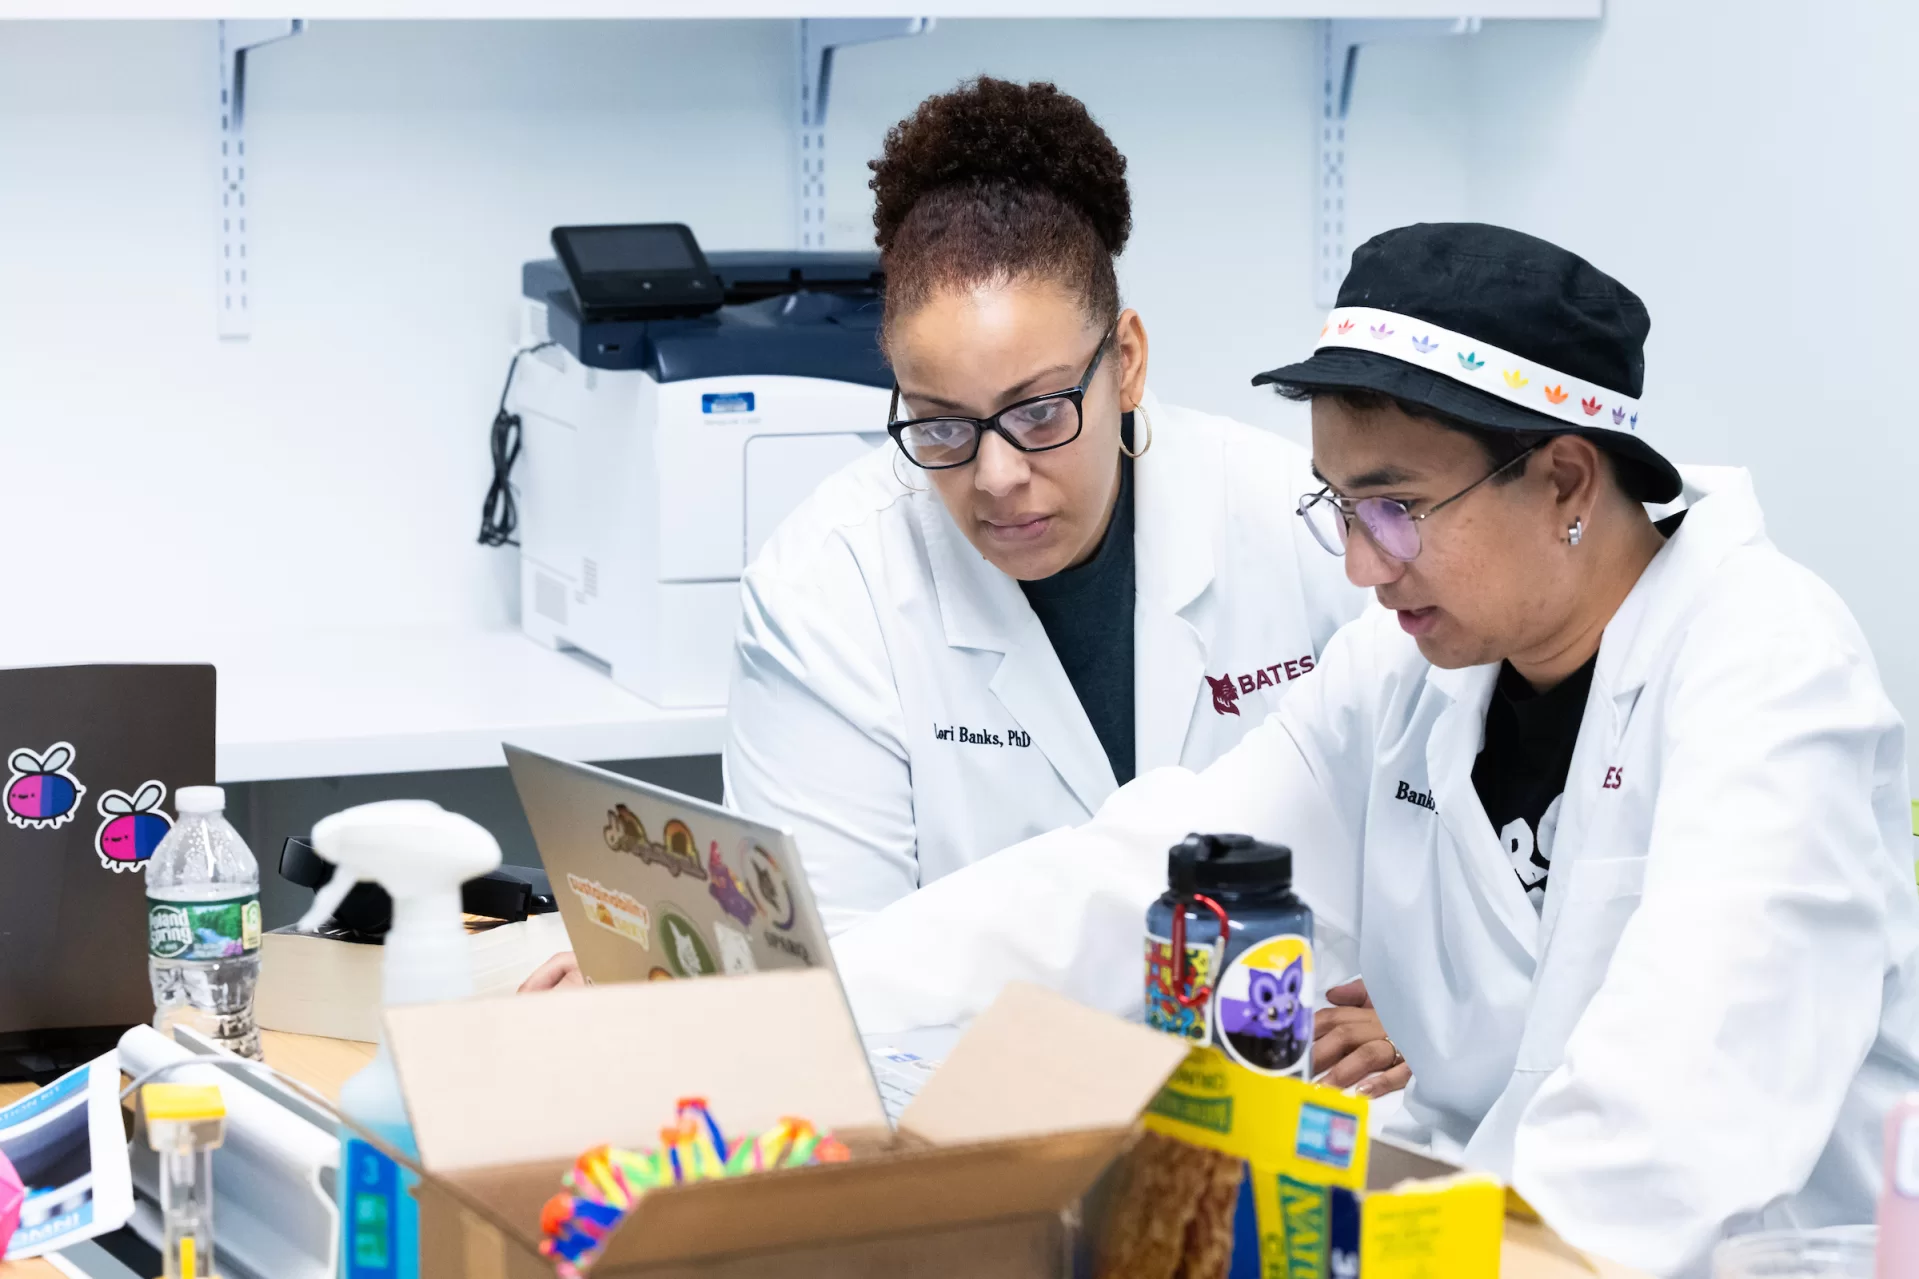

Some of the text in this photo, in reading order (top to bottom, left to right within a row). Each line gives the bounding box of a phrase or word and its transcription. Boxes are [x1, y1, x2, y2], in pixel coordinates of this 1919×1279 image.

[1237, 655, 1315, 695] BATES
[959, 726, 1004, 748] Banks,
[1007, 729, 1031, 747] PhD
